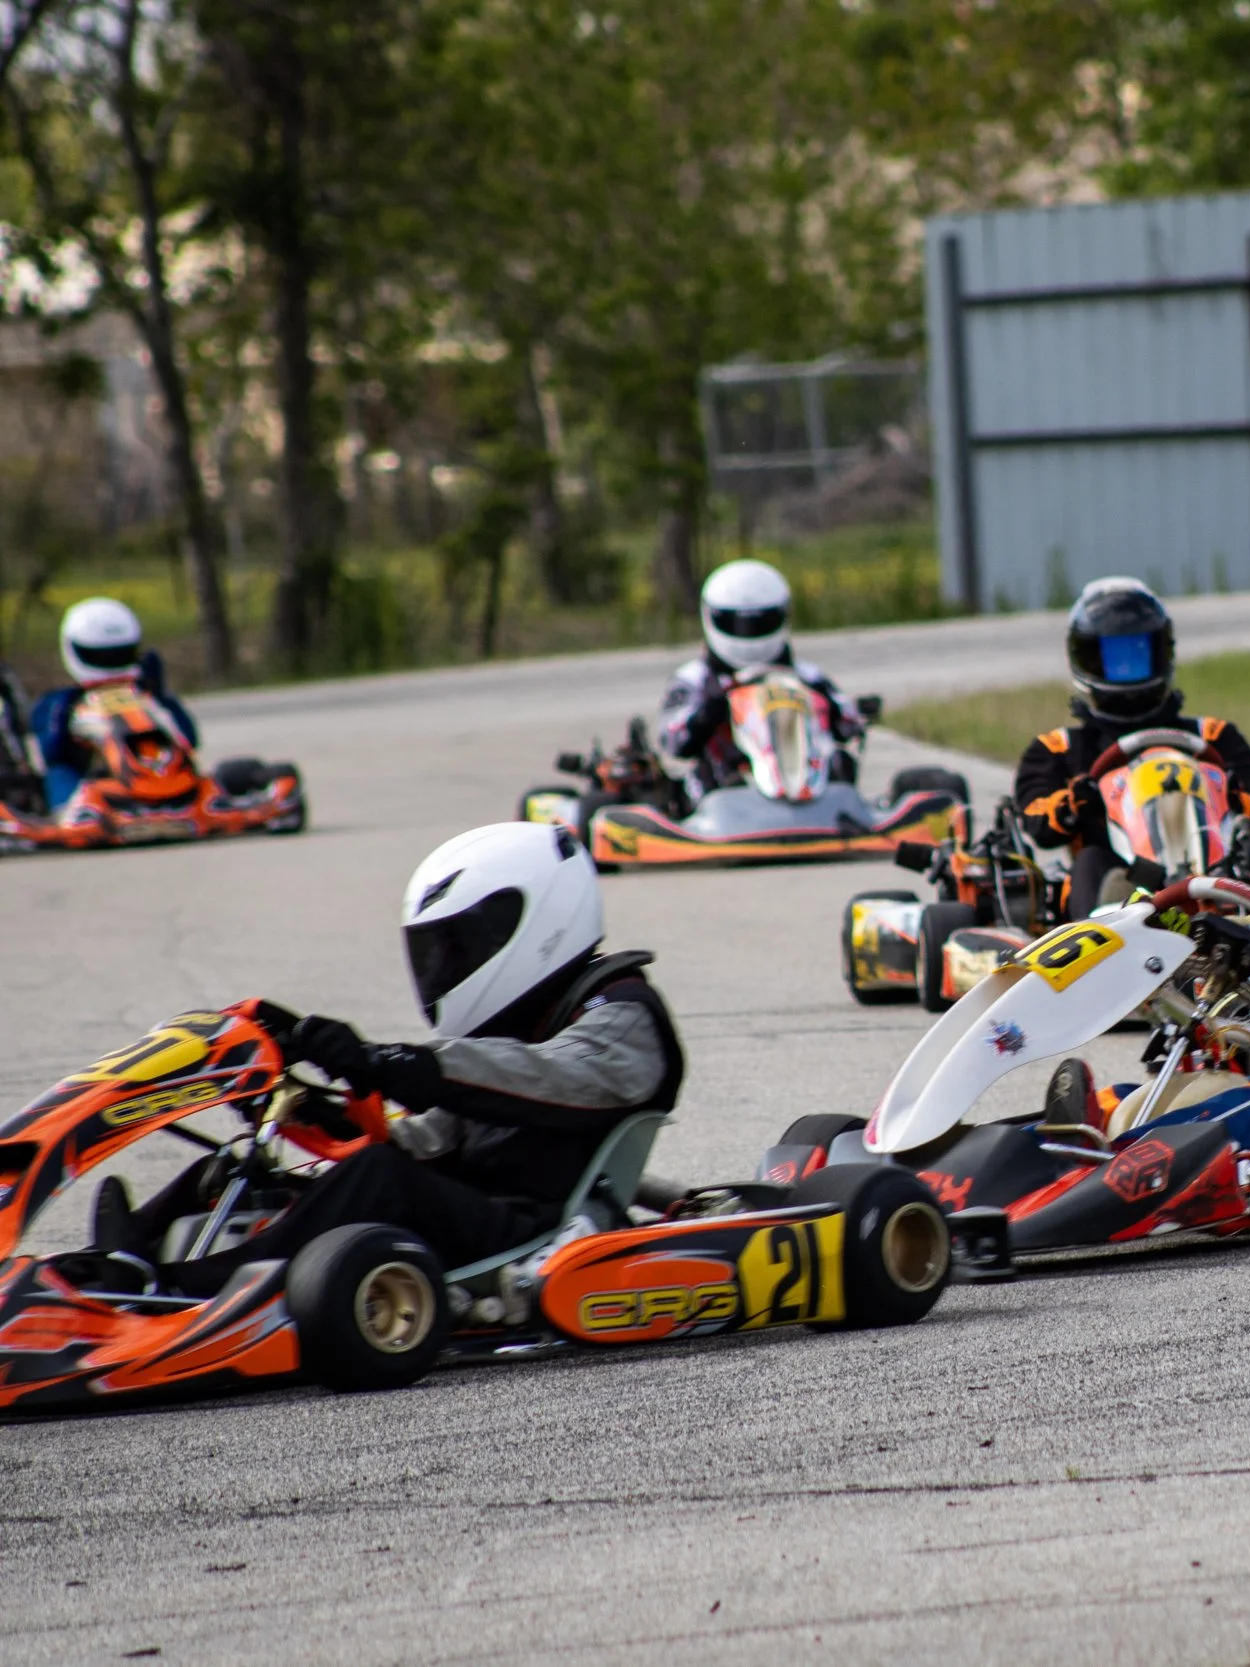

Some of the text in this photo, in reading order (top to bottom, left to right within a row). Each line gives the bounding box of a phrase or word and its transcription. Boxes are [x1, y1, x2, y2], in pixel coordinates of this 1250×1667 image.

[101, 1080, 222, 1126] CRG
[769, 1222, 821, 1324] 21
[578, 1282, 739, 1335] CRG
